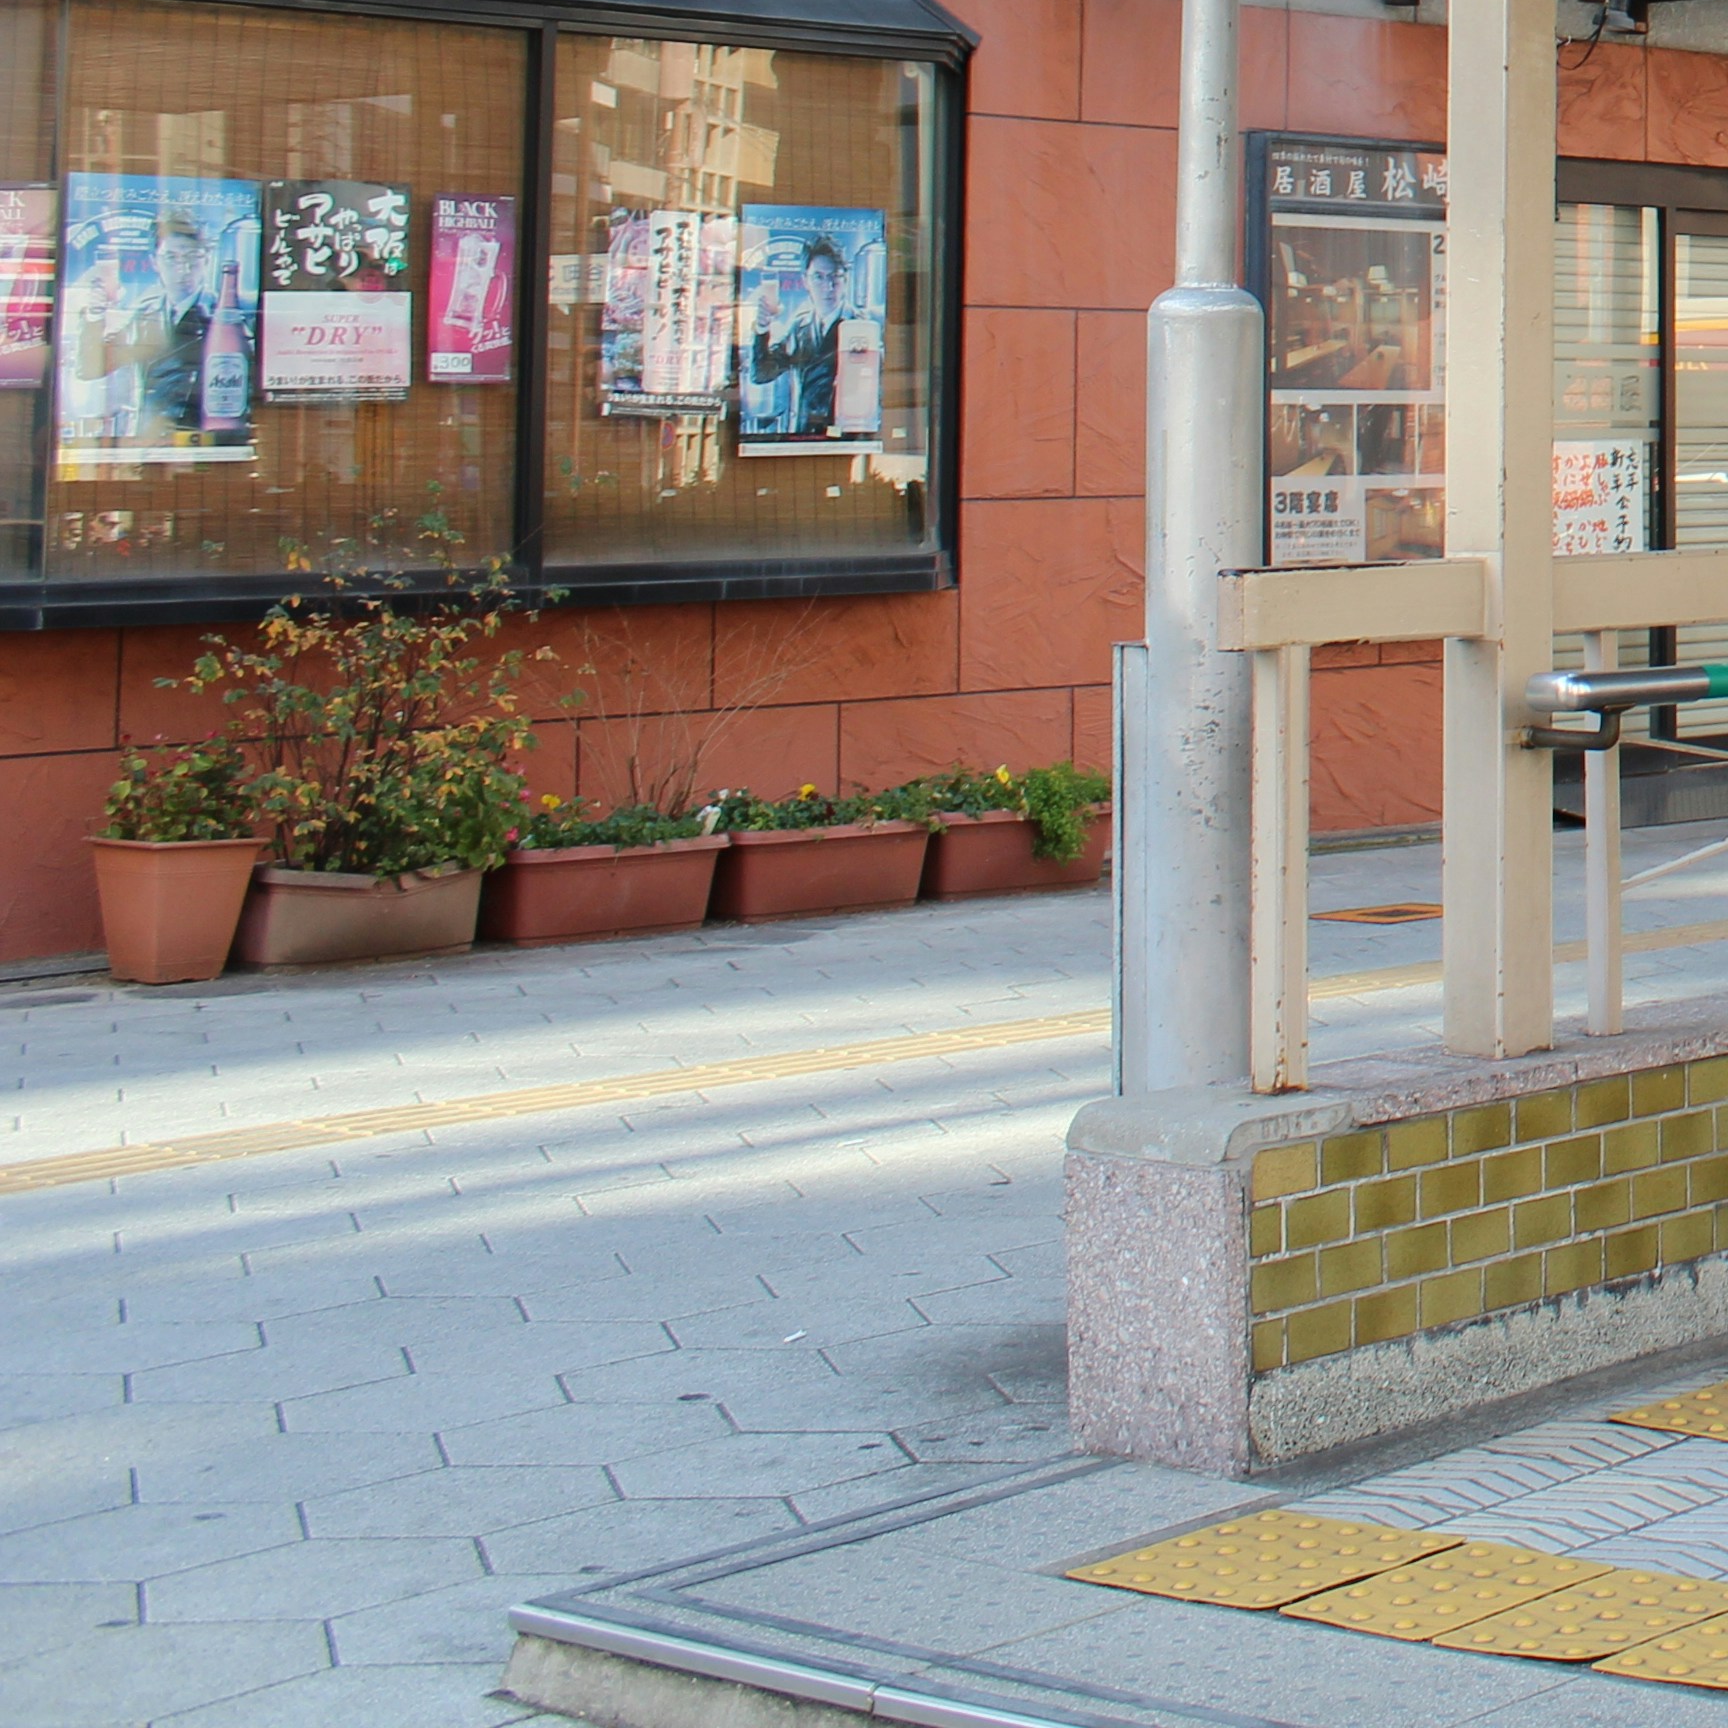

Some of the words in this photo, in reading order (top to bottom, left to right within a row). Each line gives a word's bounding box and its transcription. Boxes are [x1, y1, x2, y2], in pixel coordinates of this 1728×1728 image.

[1273, 166, 1367, 199] 居酒屋
[438, 199, 498, 219] BLACK
[297, 192, 334, 275] アサヒ
[438, 217, 497, 229] HIGHBALL
